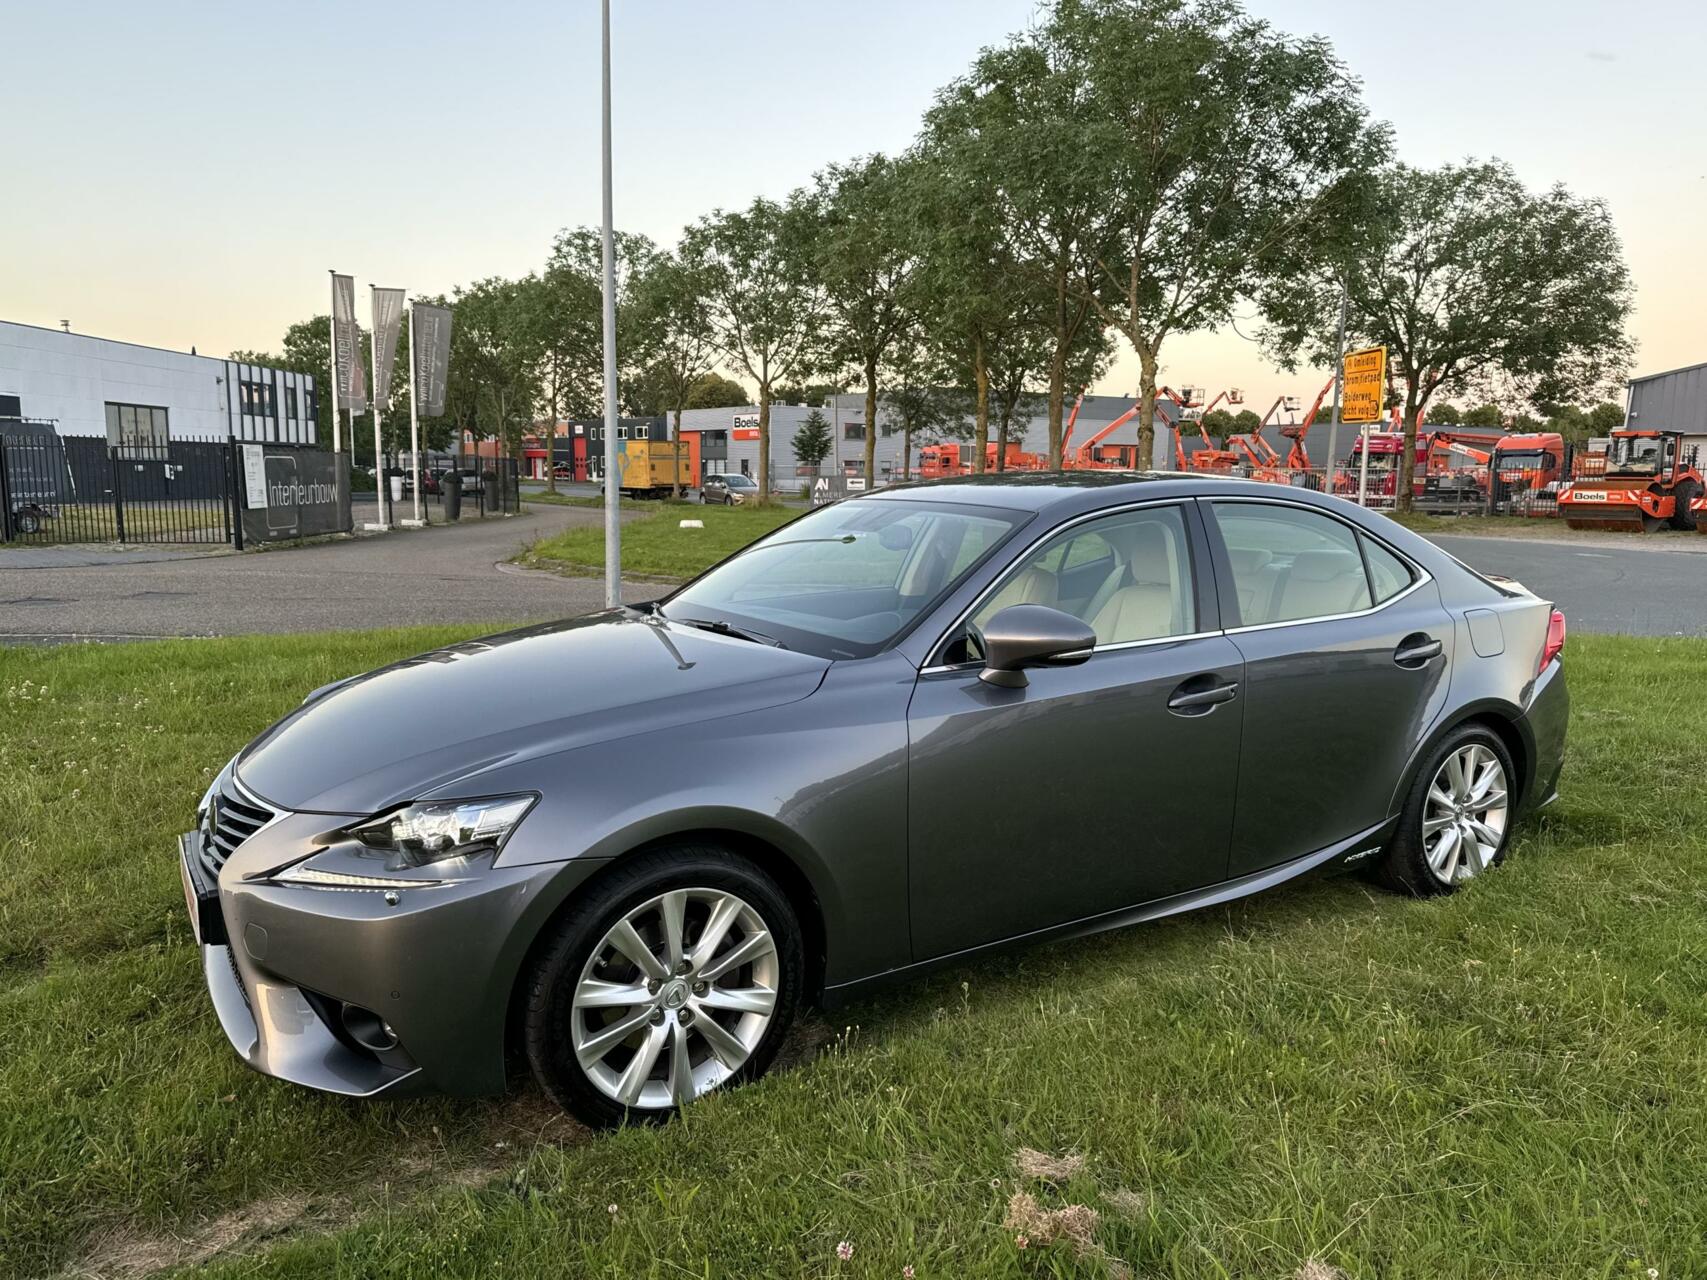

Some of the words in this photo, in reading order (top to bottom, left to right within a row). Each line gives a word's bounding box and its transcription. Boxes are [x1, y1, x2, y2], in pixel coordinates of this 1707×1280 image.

[1354, 356, 1377, 368] Omleiding
[734, 416, 760, 428] Boels
[268, 478, 338, 507] Interieurbouw
[1574, 492, 1605, 500] Boels
